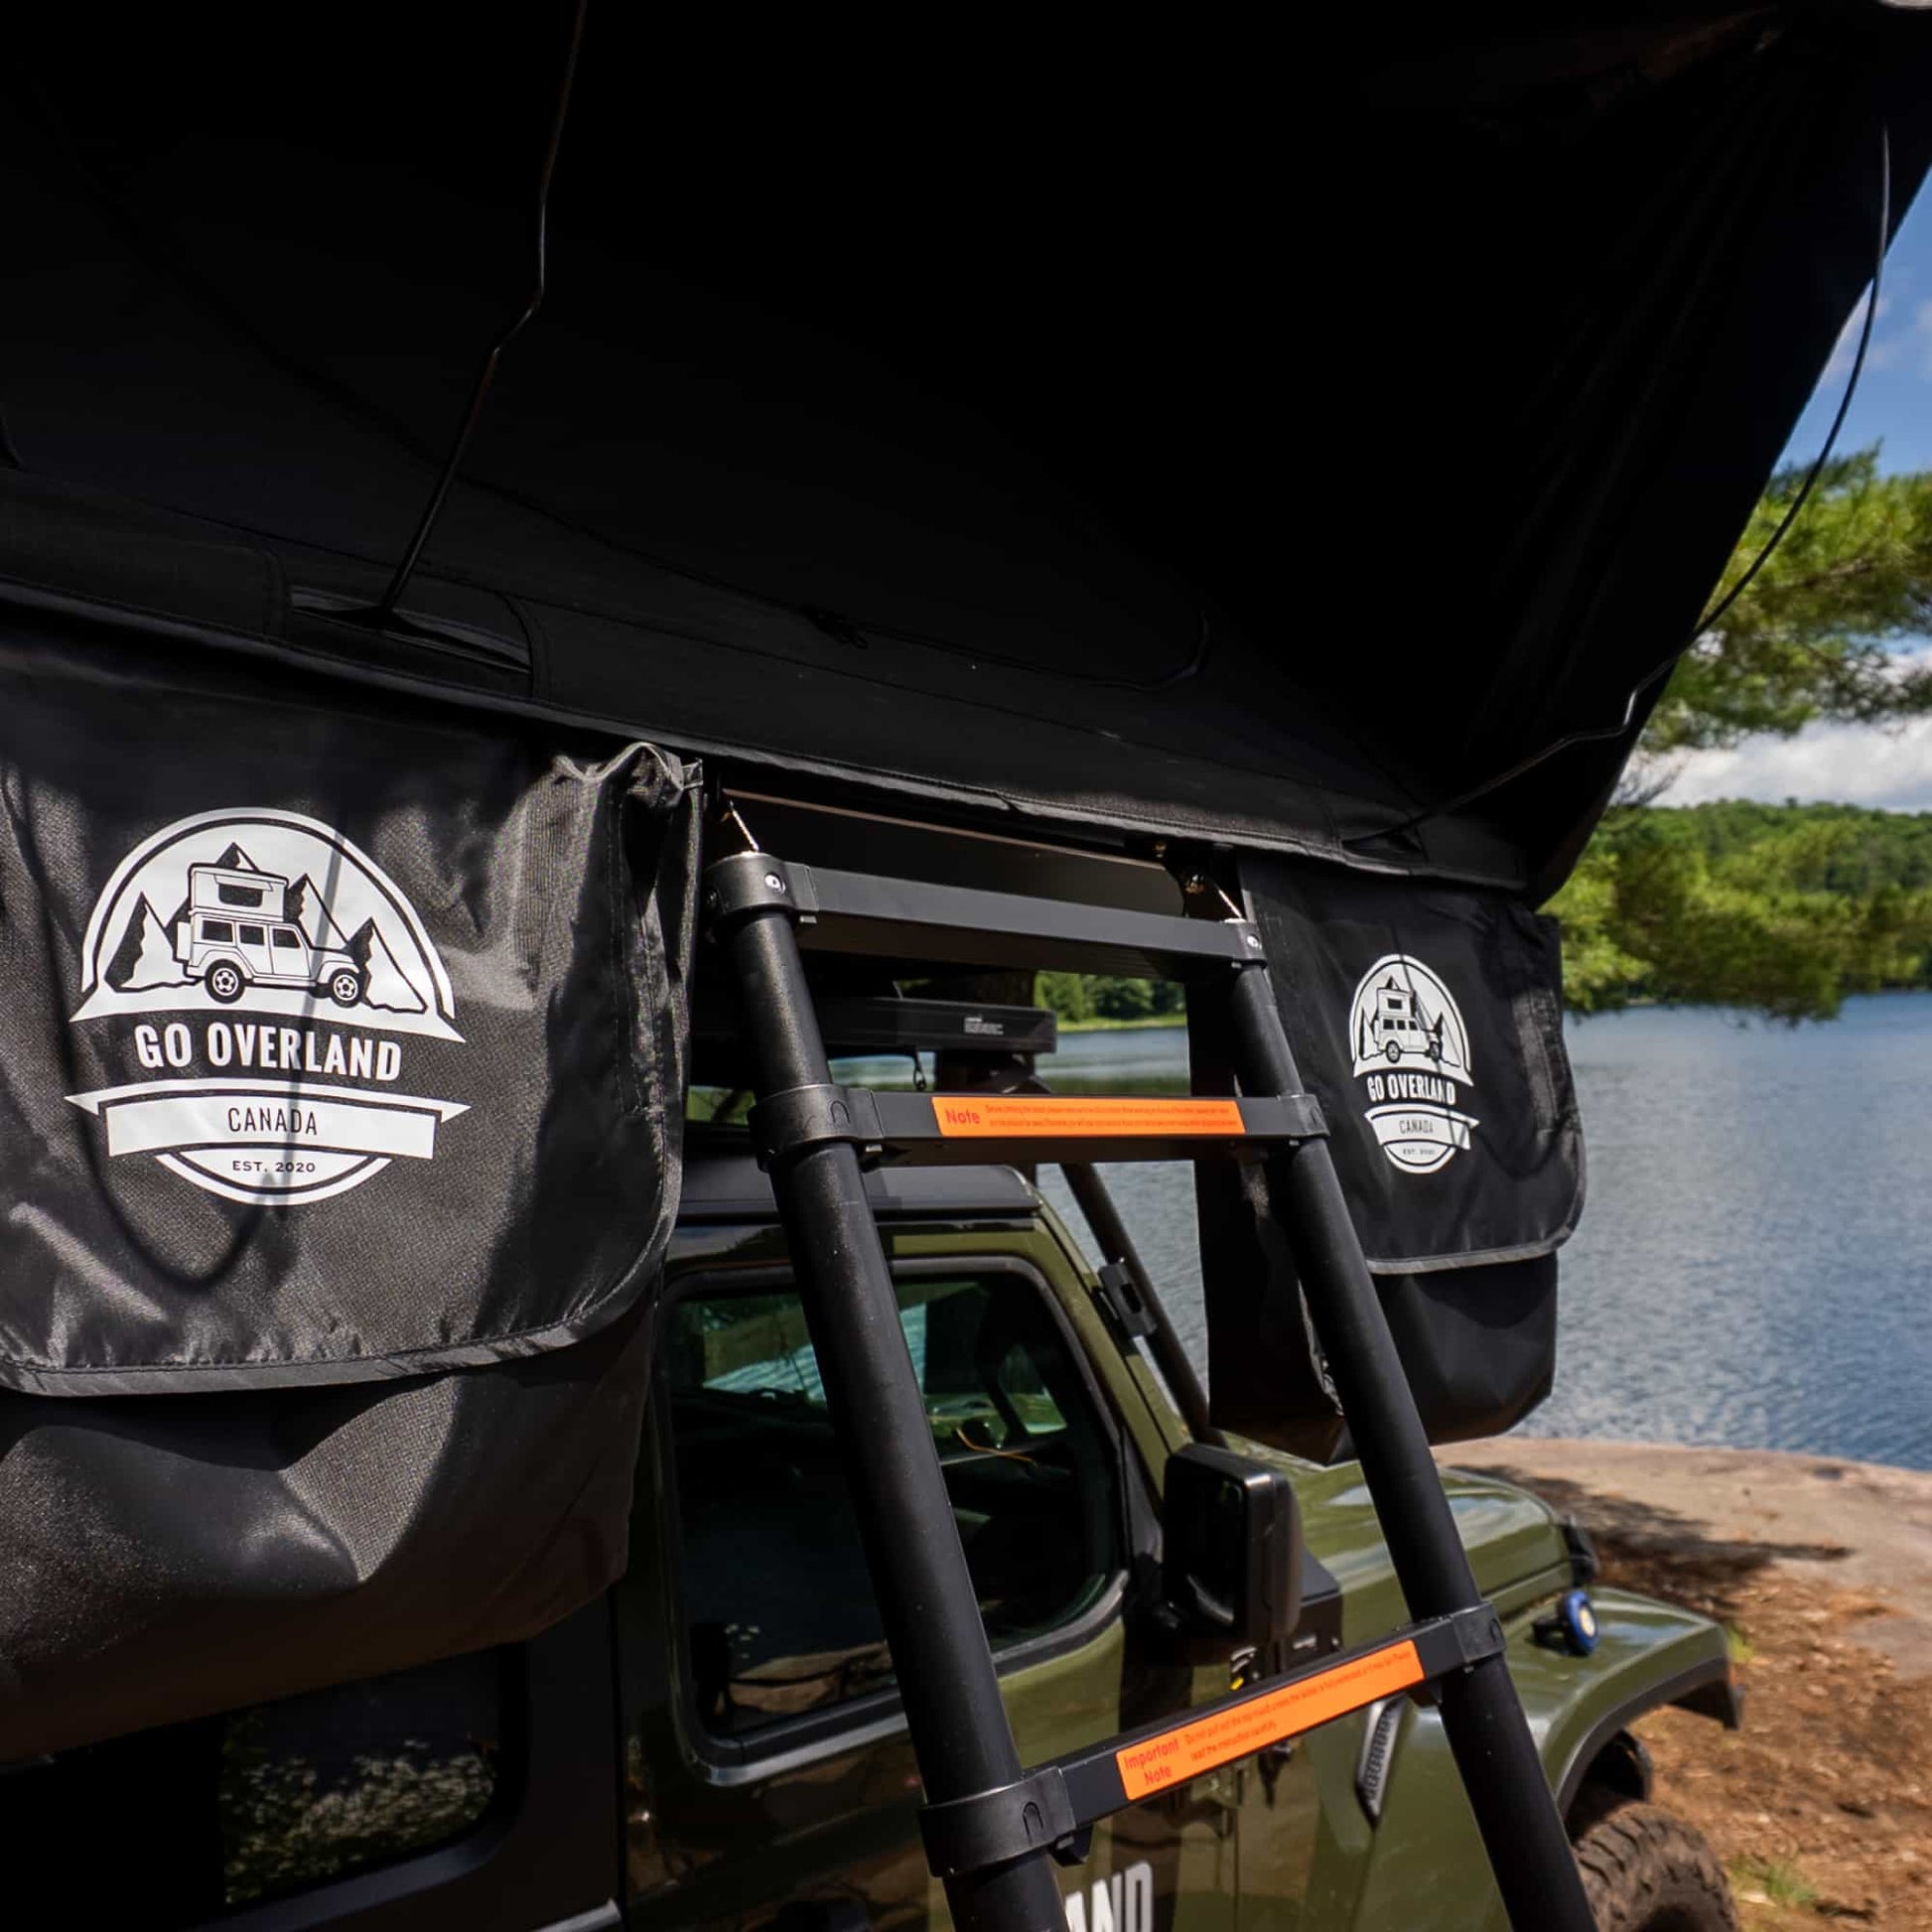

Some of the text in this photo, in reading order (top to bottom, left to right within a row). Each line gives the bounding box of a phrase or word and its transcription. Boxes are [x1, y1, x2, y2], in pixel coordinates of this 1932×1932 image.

[134, 1022, 402, 1081] GO OVERLAND
[1367, 1073, 1456, 1105] GO OVERLAND
[227, 1107, 319, 1136] CANADA
[944, 1107, 981, 1124] Note
[232, 1161, 317, 1173] EST. 2020
[1124, 1736, 1181, 1771] Important
[1144, 1765, 1173, 1786] Note
